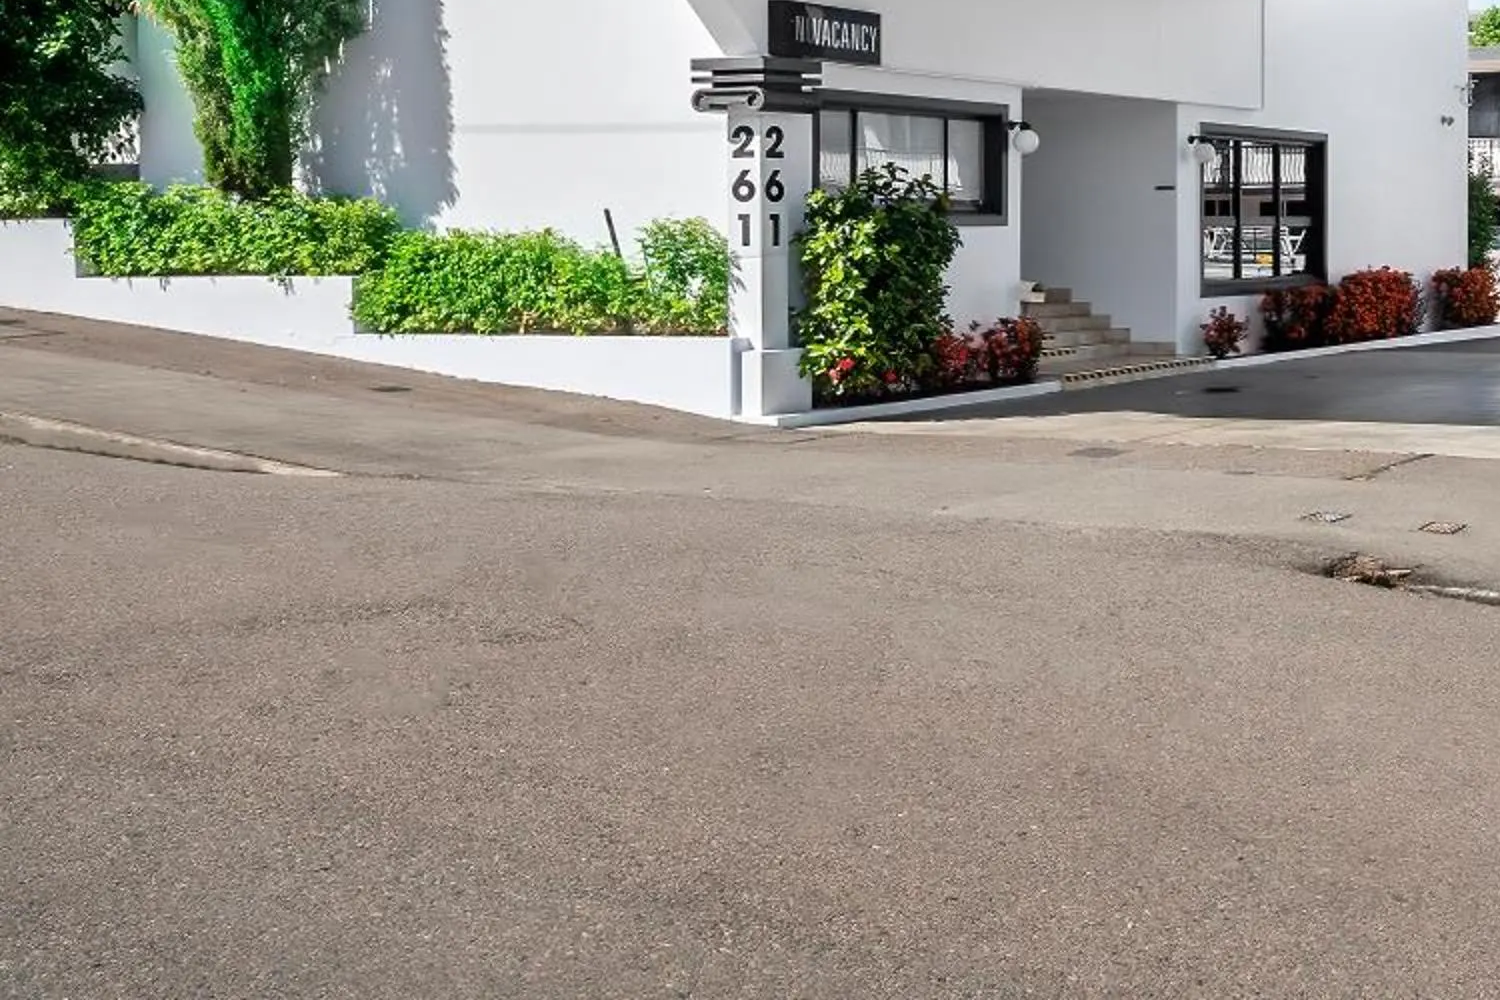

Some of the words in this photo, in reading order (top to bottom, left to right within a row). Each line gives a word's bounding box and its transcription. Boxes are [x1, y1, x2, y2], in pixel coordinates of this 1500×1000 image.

[812, 16, 877, 53] VACANCY
[731, 125, 756, 246] 261
[765, 125, 785, 246] 261
